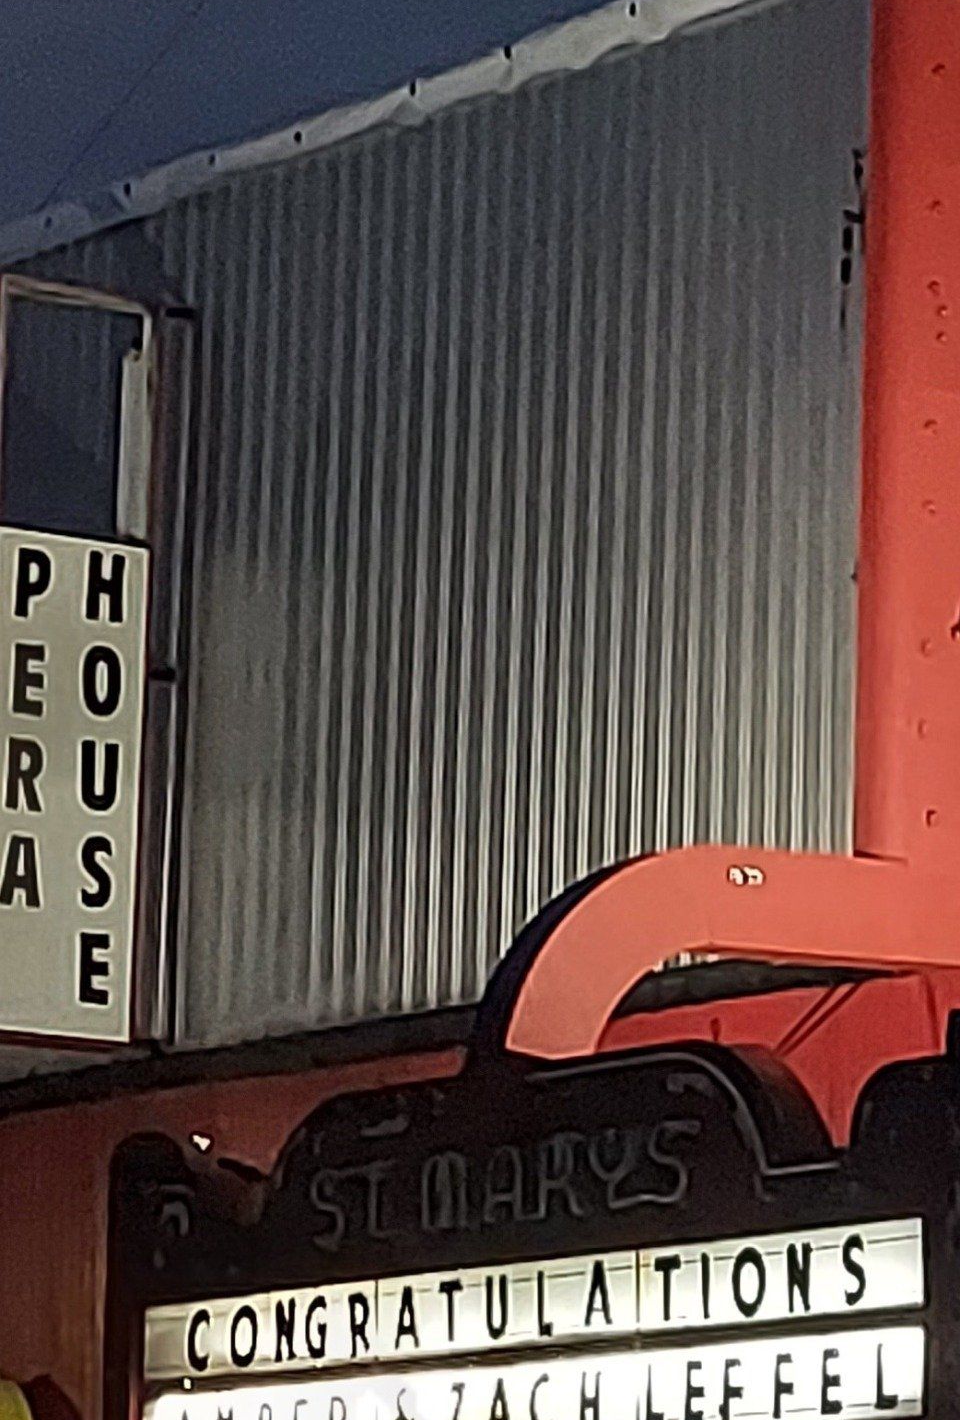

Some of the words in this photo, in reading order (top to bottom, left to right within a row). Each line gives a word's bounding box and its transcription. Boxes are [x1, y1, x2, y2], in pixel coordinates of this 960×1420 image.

[79, 549, 126, 1006] HOUSE
[421, 1120, 701, 1232] MARYS
[187, 1234, 867, 1372] CONGRATULATIONS
